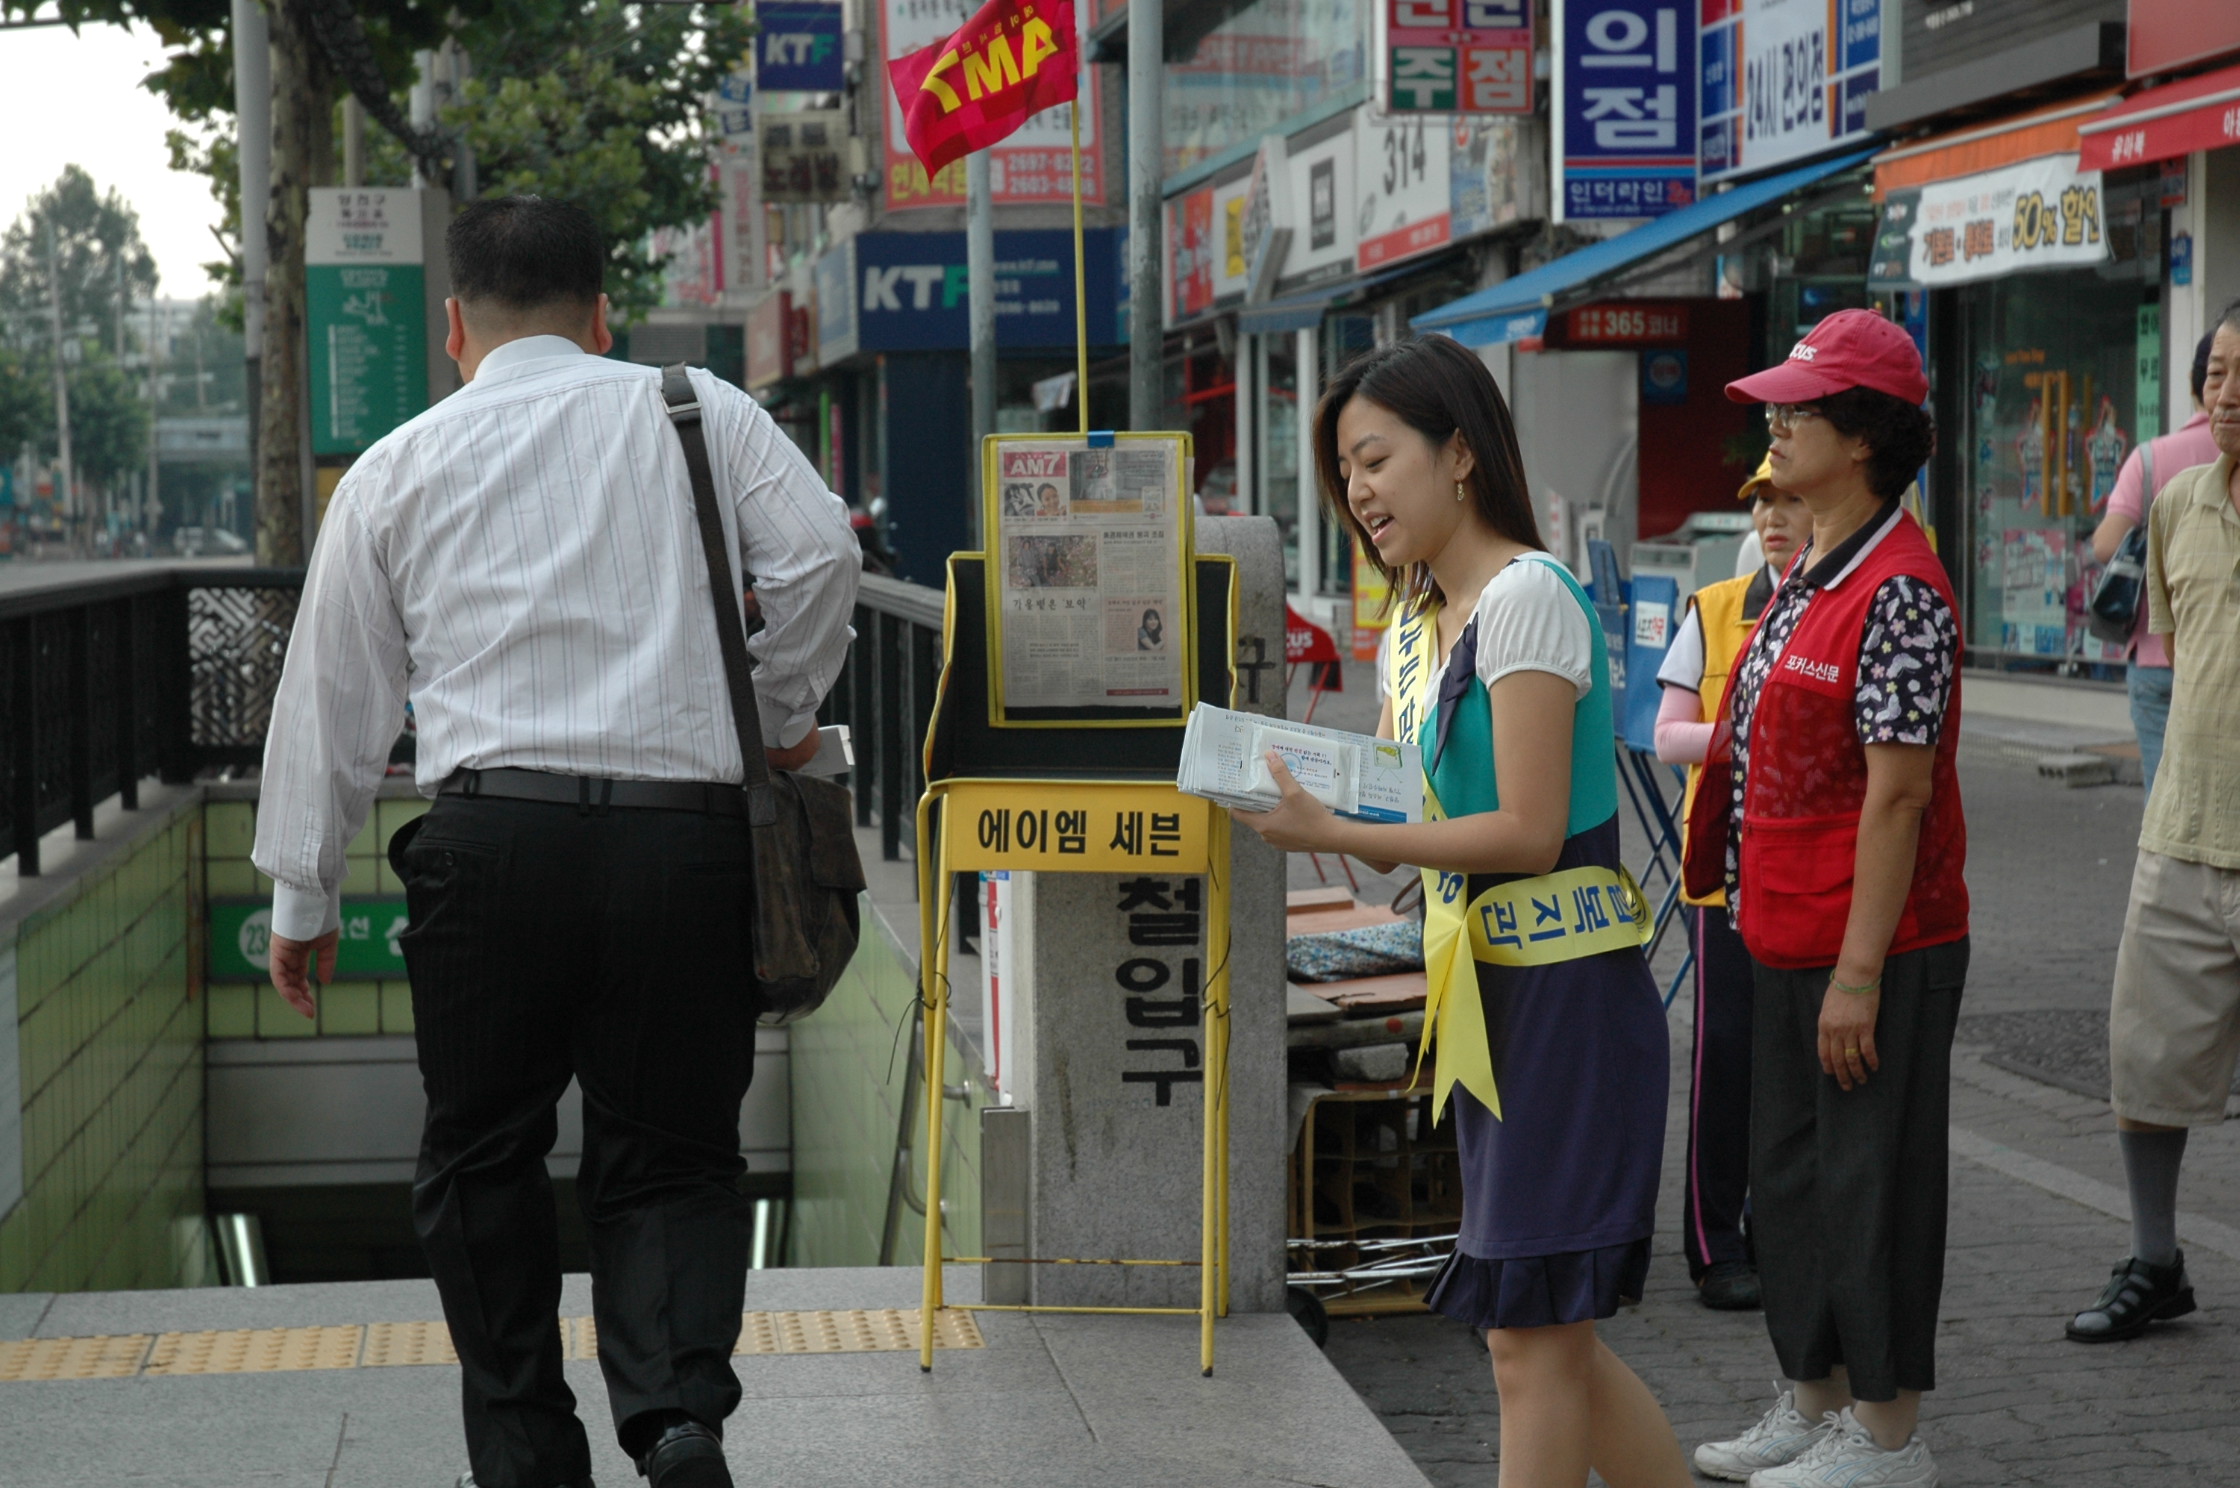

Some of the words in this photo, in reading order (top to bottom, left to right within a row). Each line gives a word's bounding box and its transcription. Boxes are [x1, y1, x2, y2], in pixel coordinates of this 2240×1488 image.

[765, 32, 836, 65] KTF
[1783, 25, 1824, 133] 편의점
[1570, 181, 1664, 203] 인더라인
[2012, 190, 2058, 251] 50%
[1605, 310, 1646, 337] 365
[1010, 454, 1061, 476] AM7
[1784, 654, 1840, 683] 포커스신문
[978, 809, 1086, 854] 에이엠
[1109, 811, 1181, 856] 세븐
